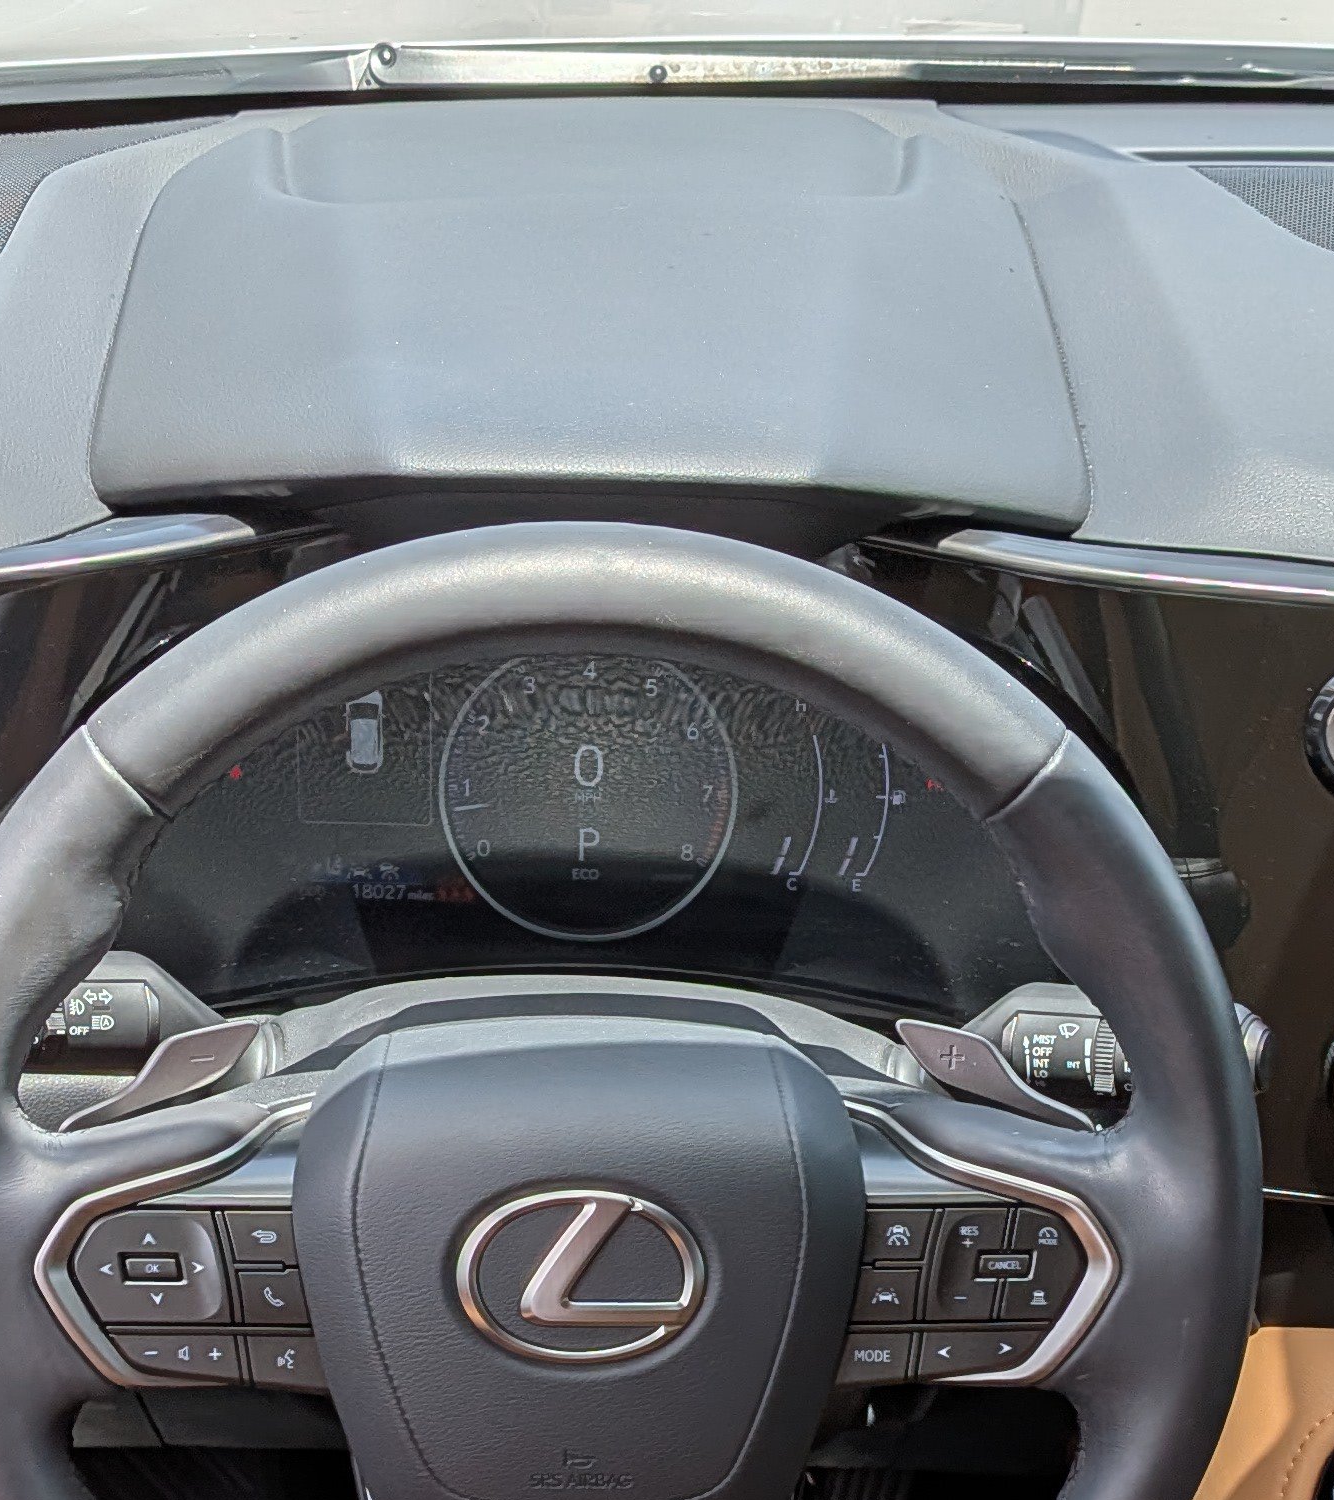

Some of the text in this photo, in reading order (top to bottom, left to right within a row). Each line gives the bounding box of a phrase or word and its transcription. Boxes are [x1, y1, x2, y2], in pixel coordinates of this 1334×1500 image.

[582, 660, 597, 680] 4
[523, 676, 536, 694] 3
[645, 678, 658, 697] 5
[477, 715, 490, 736] 2
[686, 721, 699, 740] 6
[574, 744, 604, 787] 0
[462, 777, 471, 797] 1
[701, 784, 713, 803] 7
[476, 838, 491, 857] 0
[577, 827, 601, 862] P
[679, 843, 694, 862] 8
[571, 868, 600, 881] ECO
[351, 883, 407, 900] 18027
[785, 877, 798, 892] C
[851, 878, 862, 893] E
[69, 1025, 90, 1036] OFF
[1032, 1034, 1058, 1045] MIST
[1032, 1046, 1053, 1057] OFF
[1032, 1058, 1050, 1068] INT
[1033, 1069, 1049, 1078] LO
[958, 1225, 980, 1237] RES
[144, 1263, 160, 1275] OK
[987, 1259, 1022, 1271] CANCEL
[854, 1349, 892, 1363] MODE
